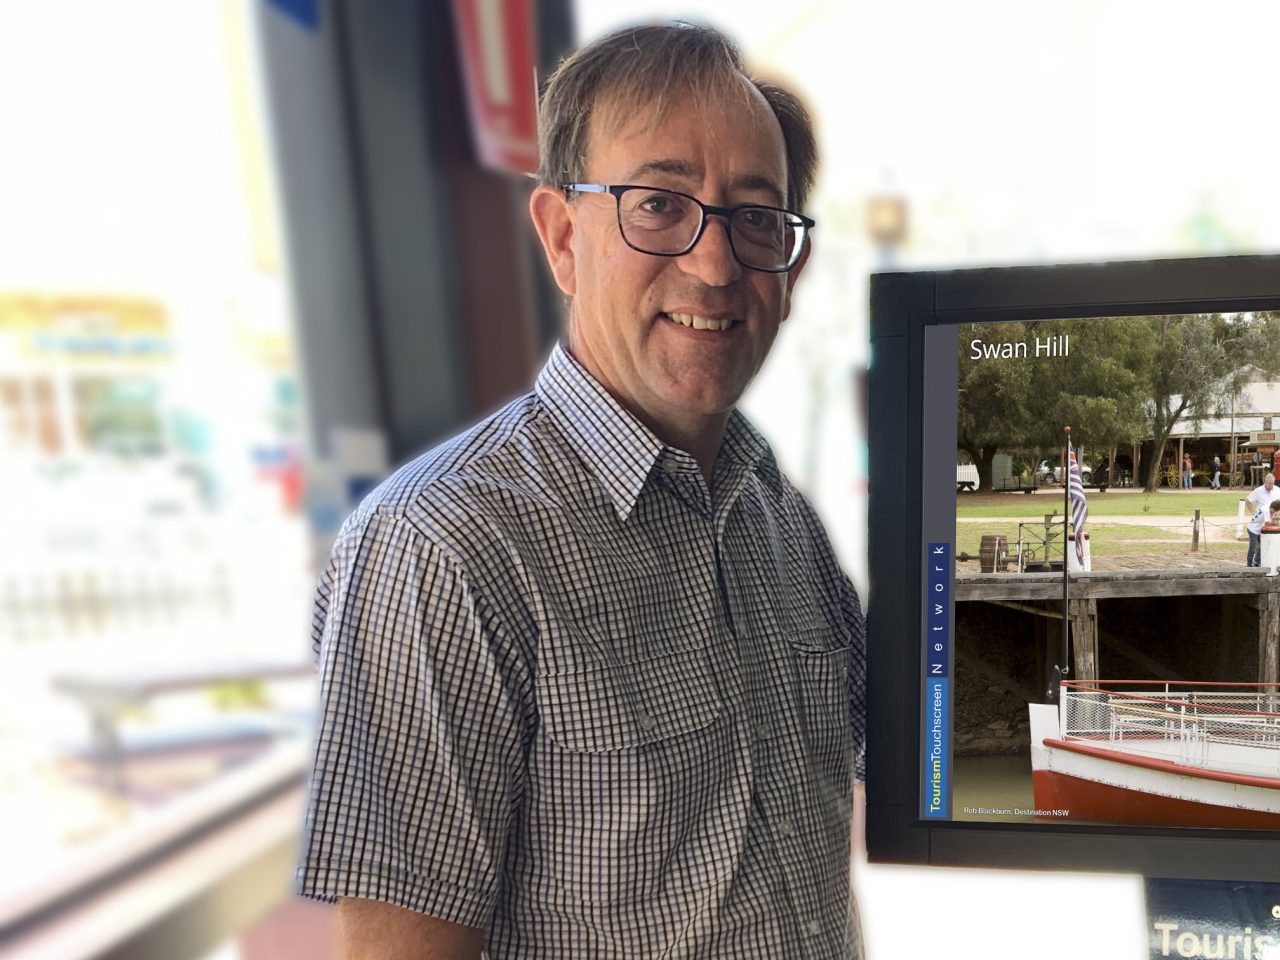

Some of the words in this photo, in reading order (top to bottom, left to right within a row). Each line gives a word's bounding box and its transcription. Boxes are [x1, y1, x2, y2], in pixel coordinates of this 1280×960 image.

[970, 339, 1027, 360] Swan
[1035, 334, 1069, 357] Hill
[931, 546, 944, 674] Network
[930, 683, 942, 813] TourismTouchscreen
[1014, 808, 1051, 816] Destination
